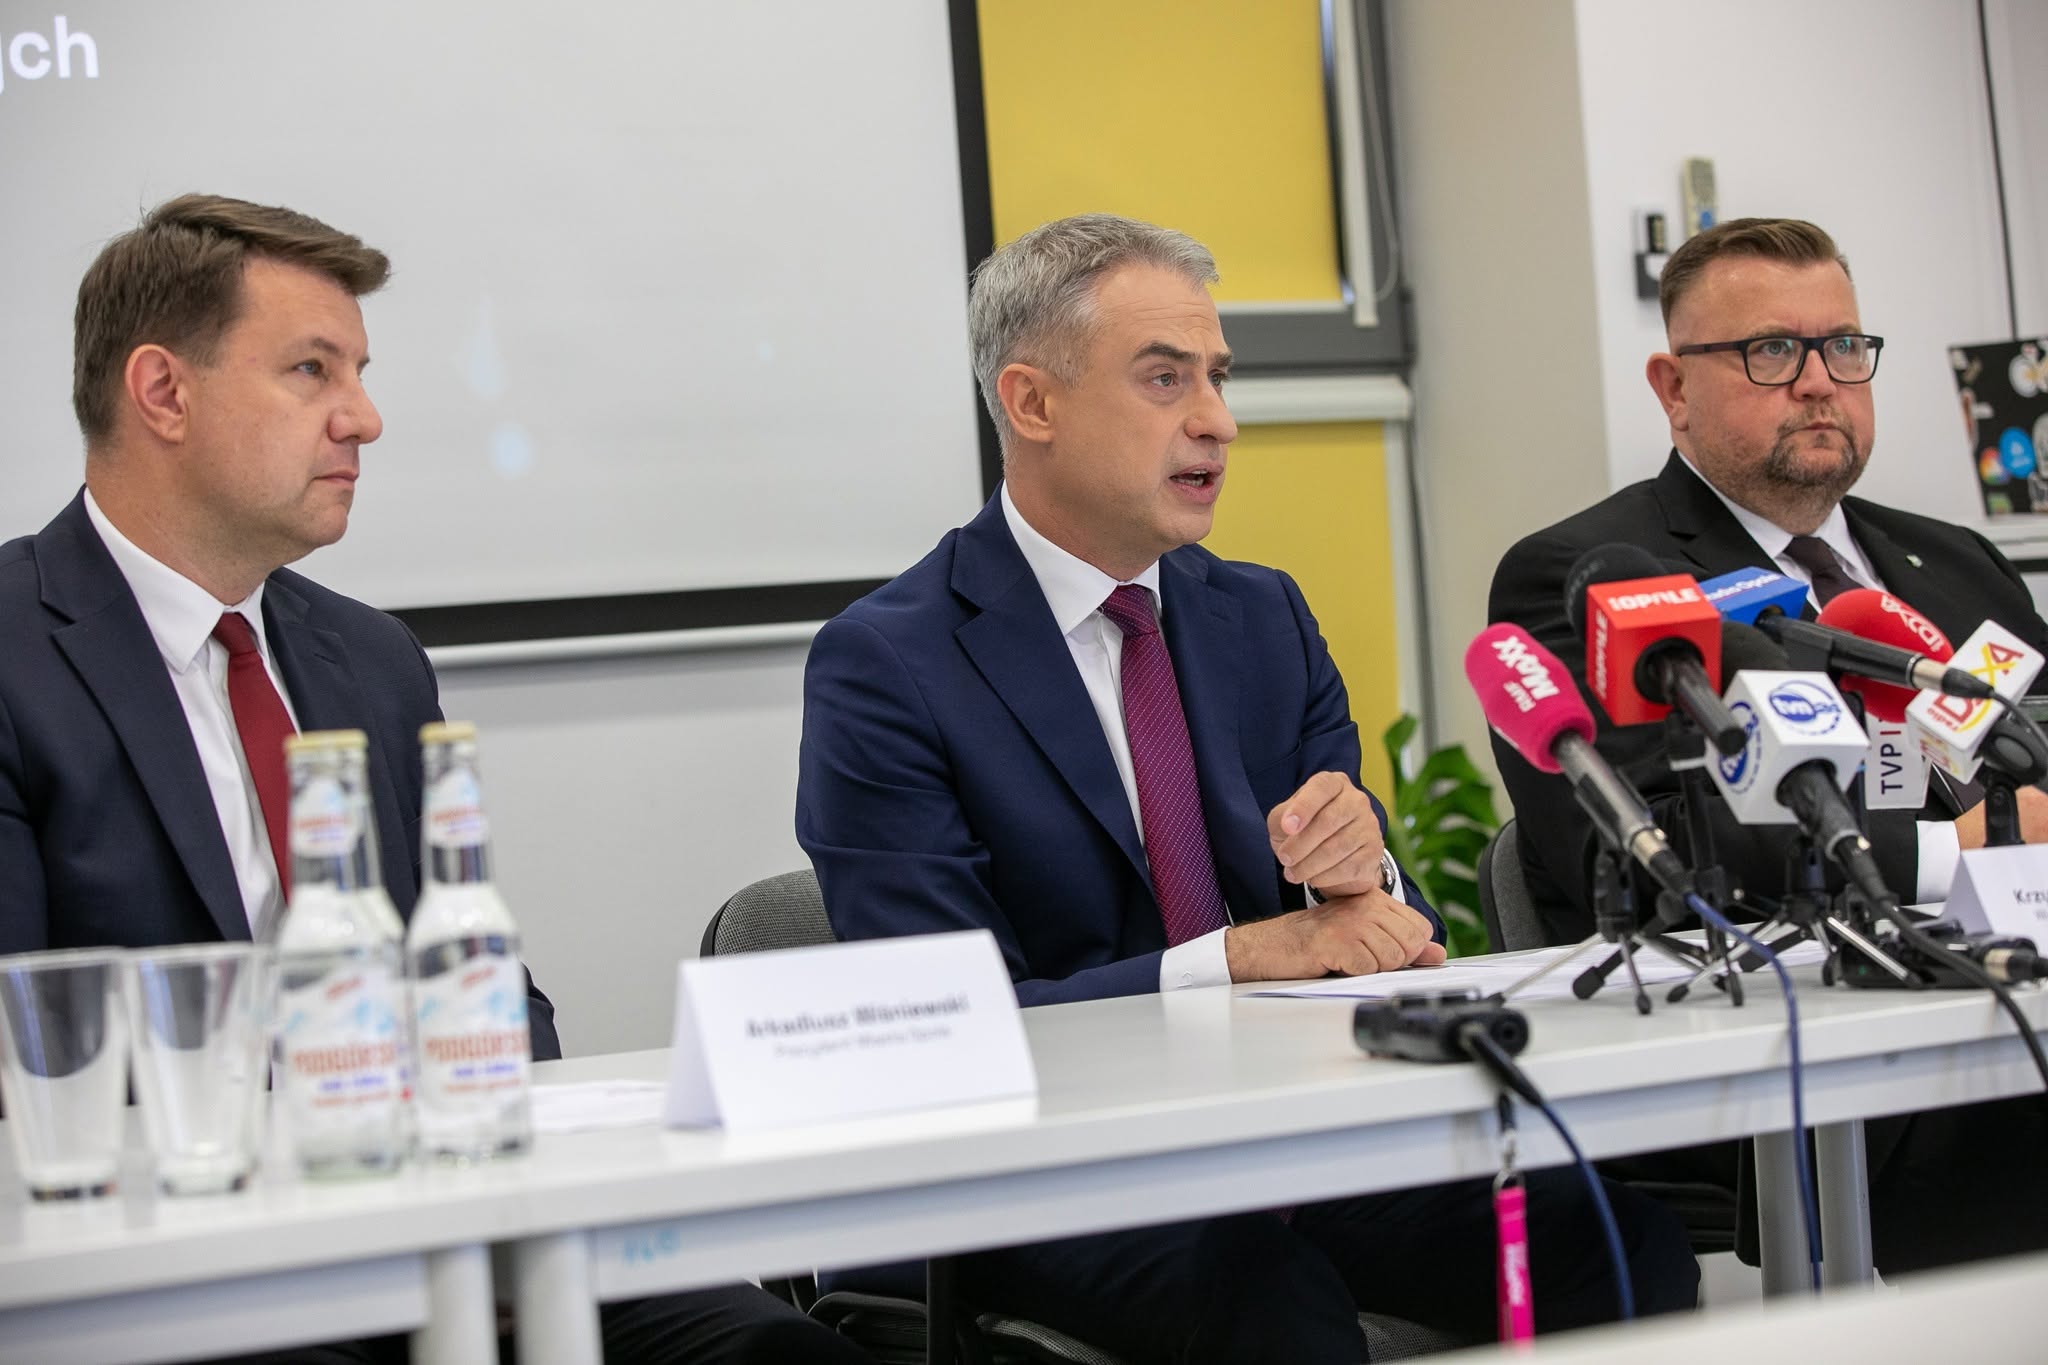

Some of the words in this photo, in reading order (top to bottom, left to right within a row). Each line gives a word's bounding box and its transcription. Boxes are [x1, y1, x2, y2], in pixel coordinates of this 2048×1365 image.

[0, 15, 99, 94] ch
[1932, 641, 2025, 725] DXA
[1880, 743, 1903, 795] TVP
